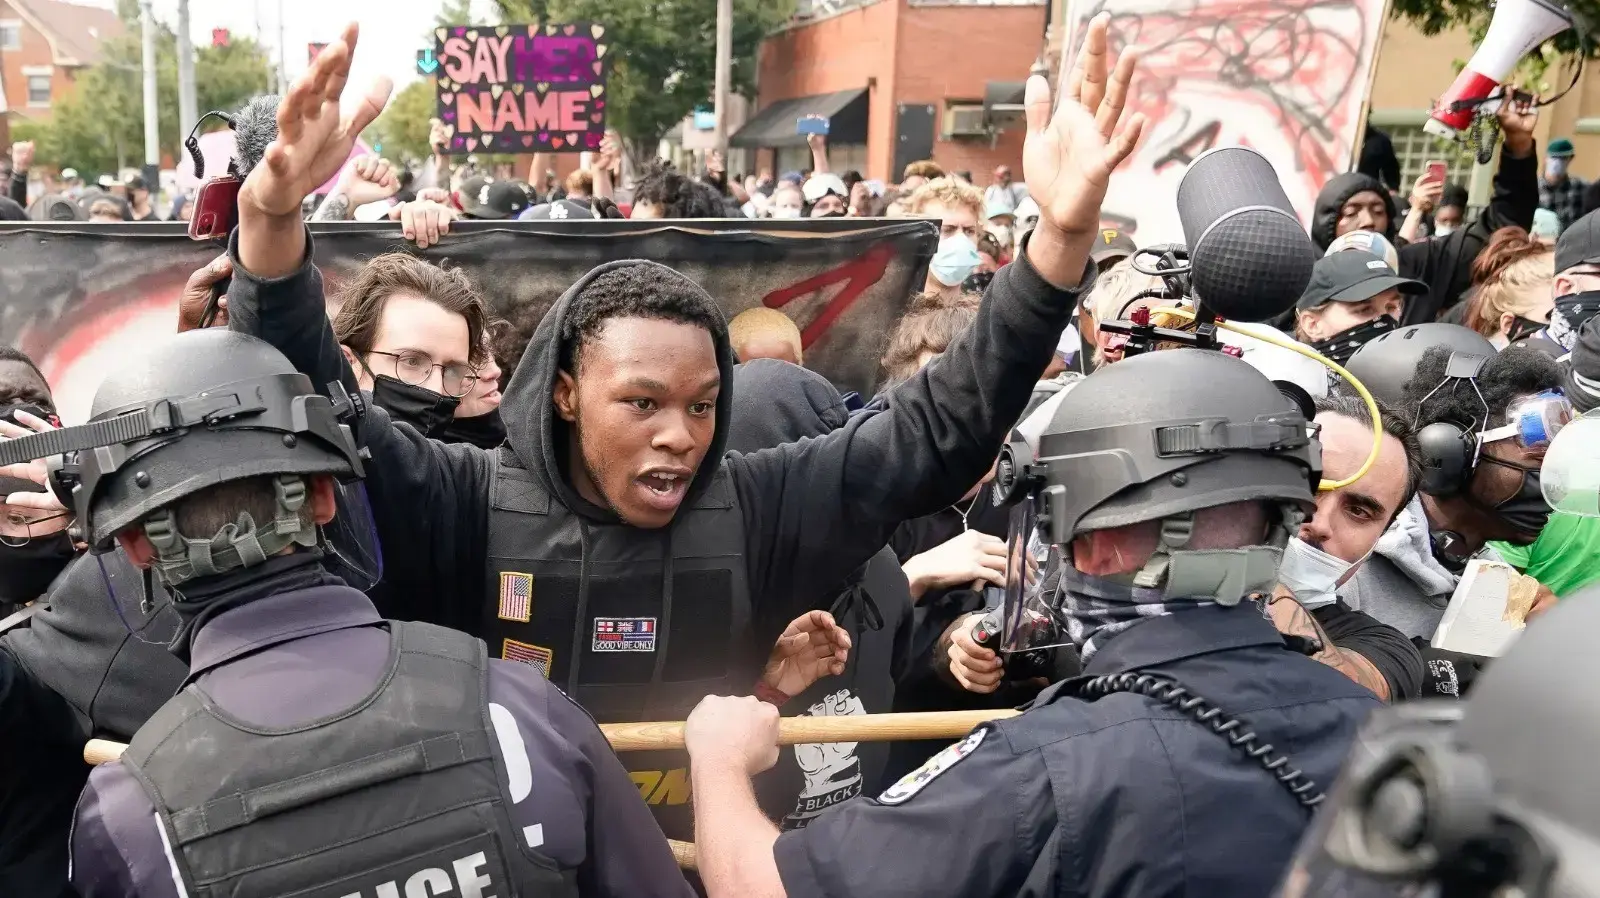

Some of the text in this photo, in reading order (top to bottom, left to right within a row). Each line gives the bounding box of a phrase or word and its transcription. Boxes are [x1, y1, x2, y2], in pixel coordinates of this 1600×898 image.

[444, 36, 597, 84] SAY HER
[456, 90, 590, 133] NAME
[1103, 230, 1118, 245] P
[595, 641, 653, 650] GOOD VIBE ONLY
[805, 786, 852, 811] BLACK
